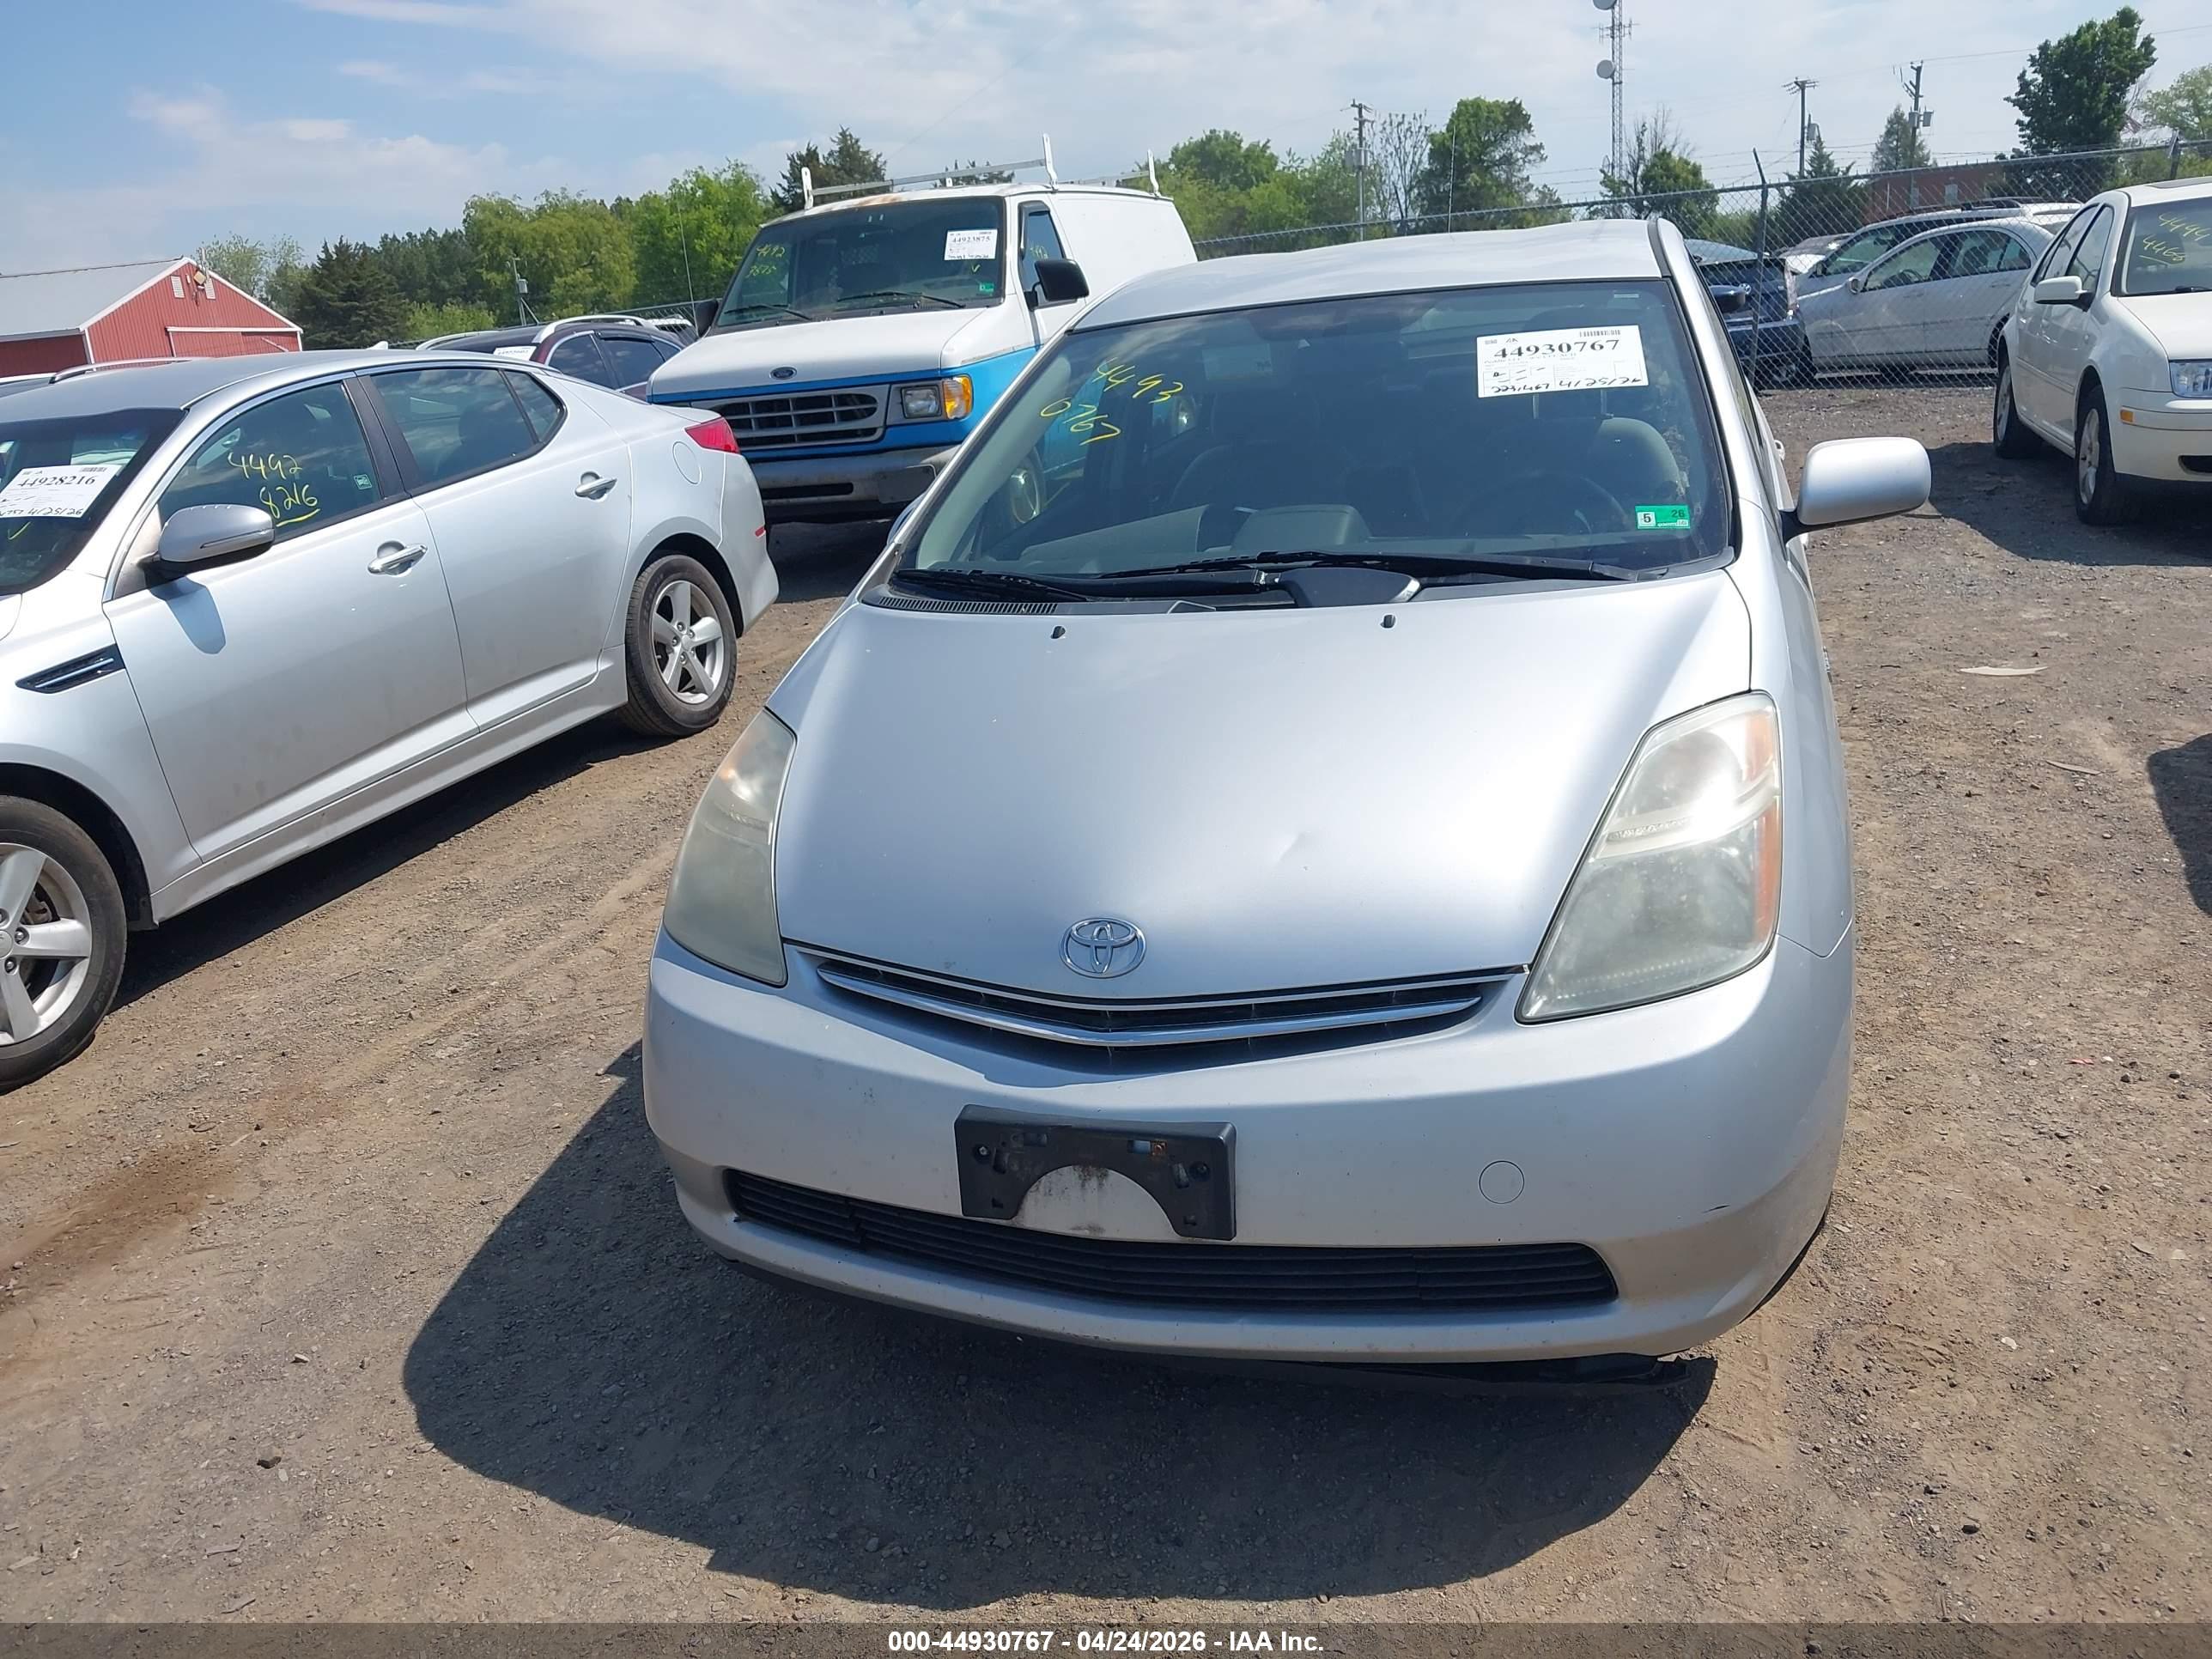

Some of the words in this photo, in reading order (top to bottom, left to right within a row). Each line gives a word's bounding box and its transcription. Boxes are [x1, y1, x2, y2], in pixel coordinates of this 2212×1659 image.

[1493, 339, 1620, 359] 44930767
[1092, 357, 1184, 404] 4493
[1040, 398, 1121, 447] 0767
[228, 452, 303, 481] 4492
[17, 475, 96, 487] 44928216
[27, 507, 84, 516] 4/25/26
[259, 482, 318, 520] 8216
[1643, 513, 1651, 524] 5
